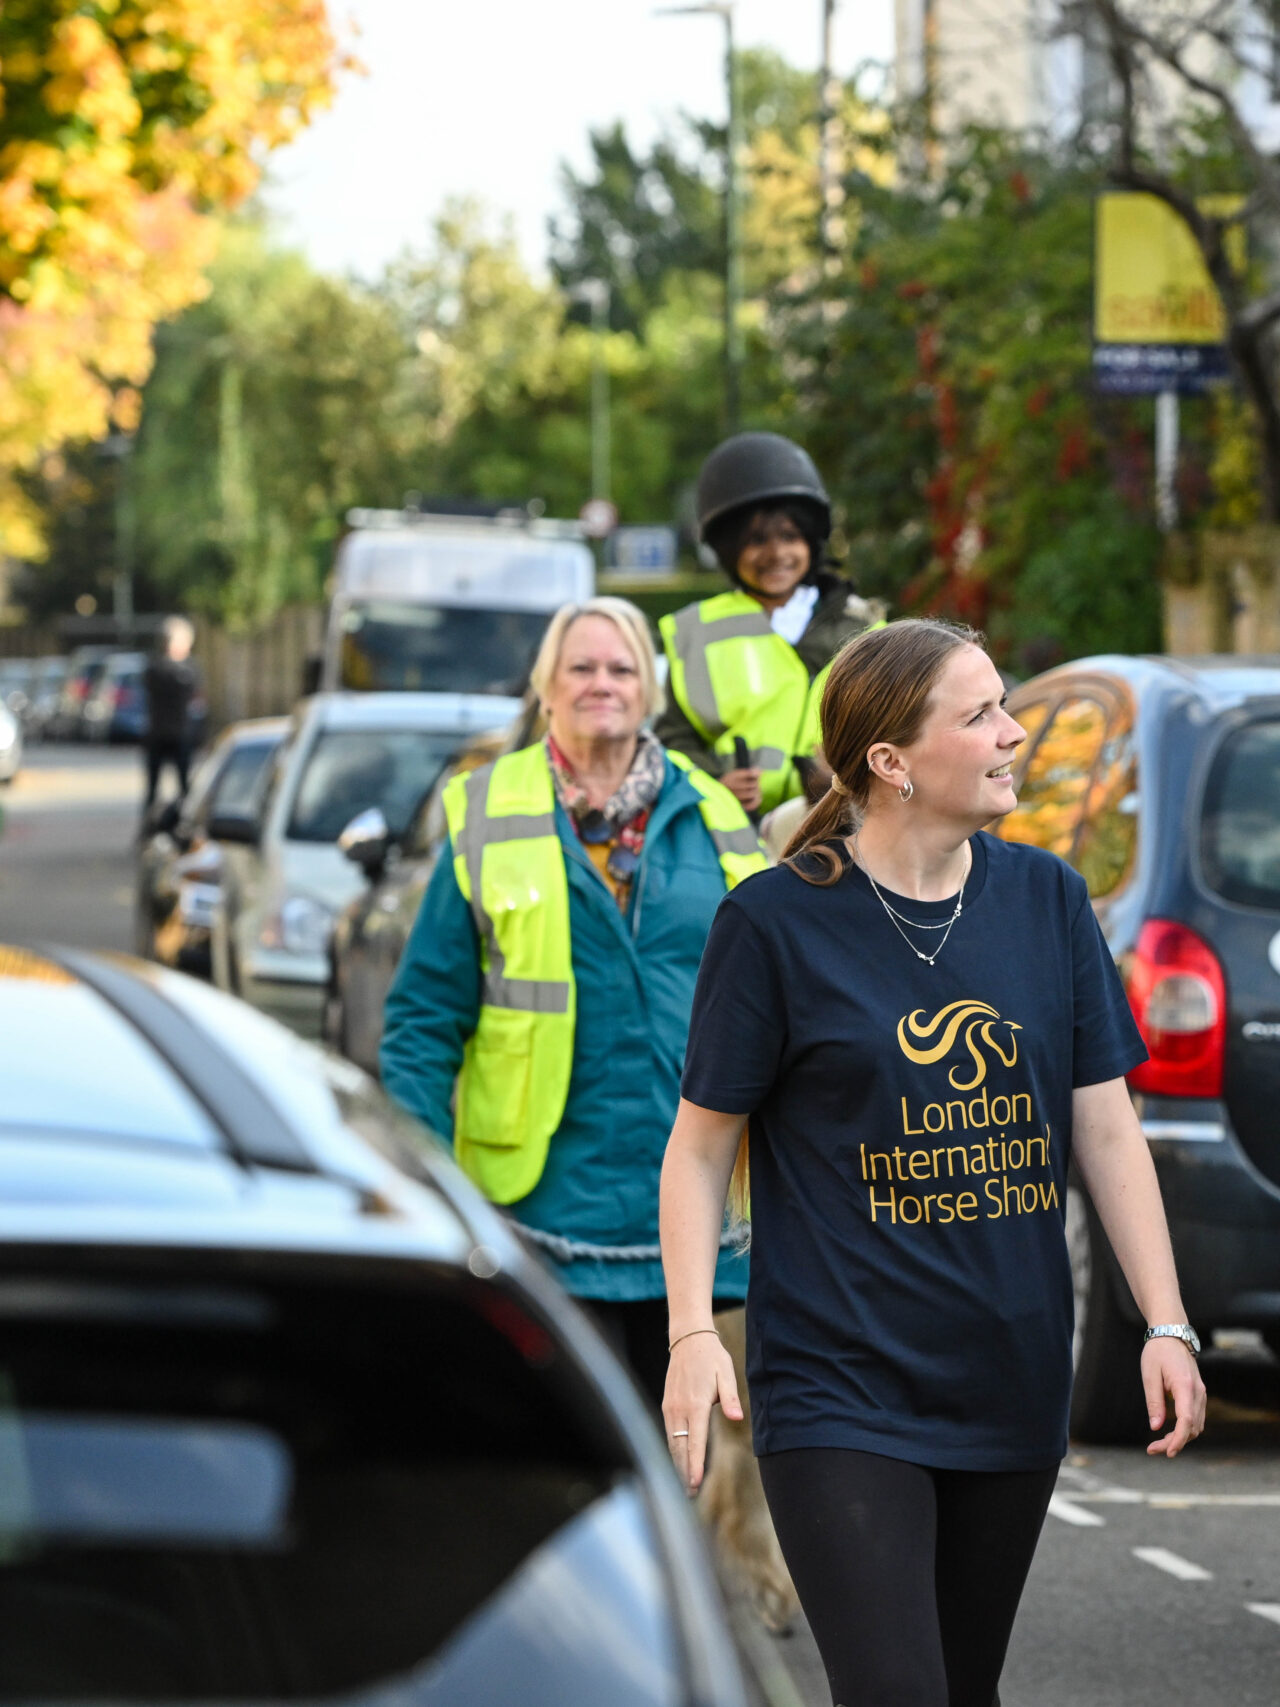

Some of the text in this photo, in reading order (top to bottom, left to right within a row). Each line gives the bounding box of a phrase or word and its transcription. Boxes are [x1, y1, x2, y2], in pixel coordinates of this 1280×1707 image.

[901, 1086, 1032, 1136] London
[869, 1175, 1059, 1225] Horse Show
